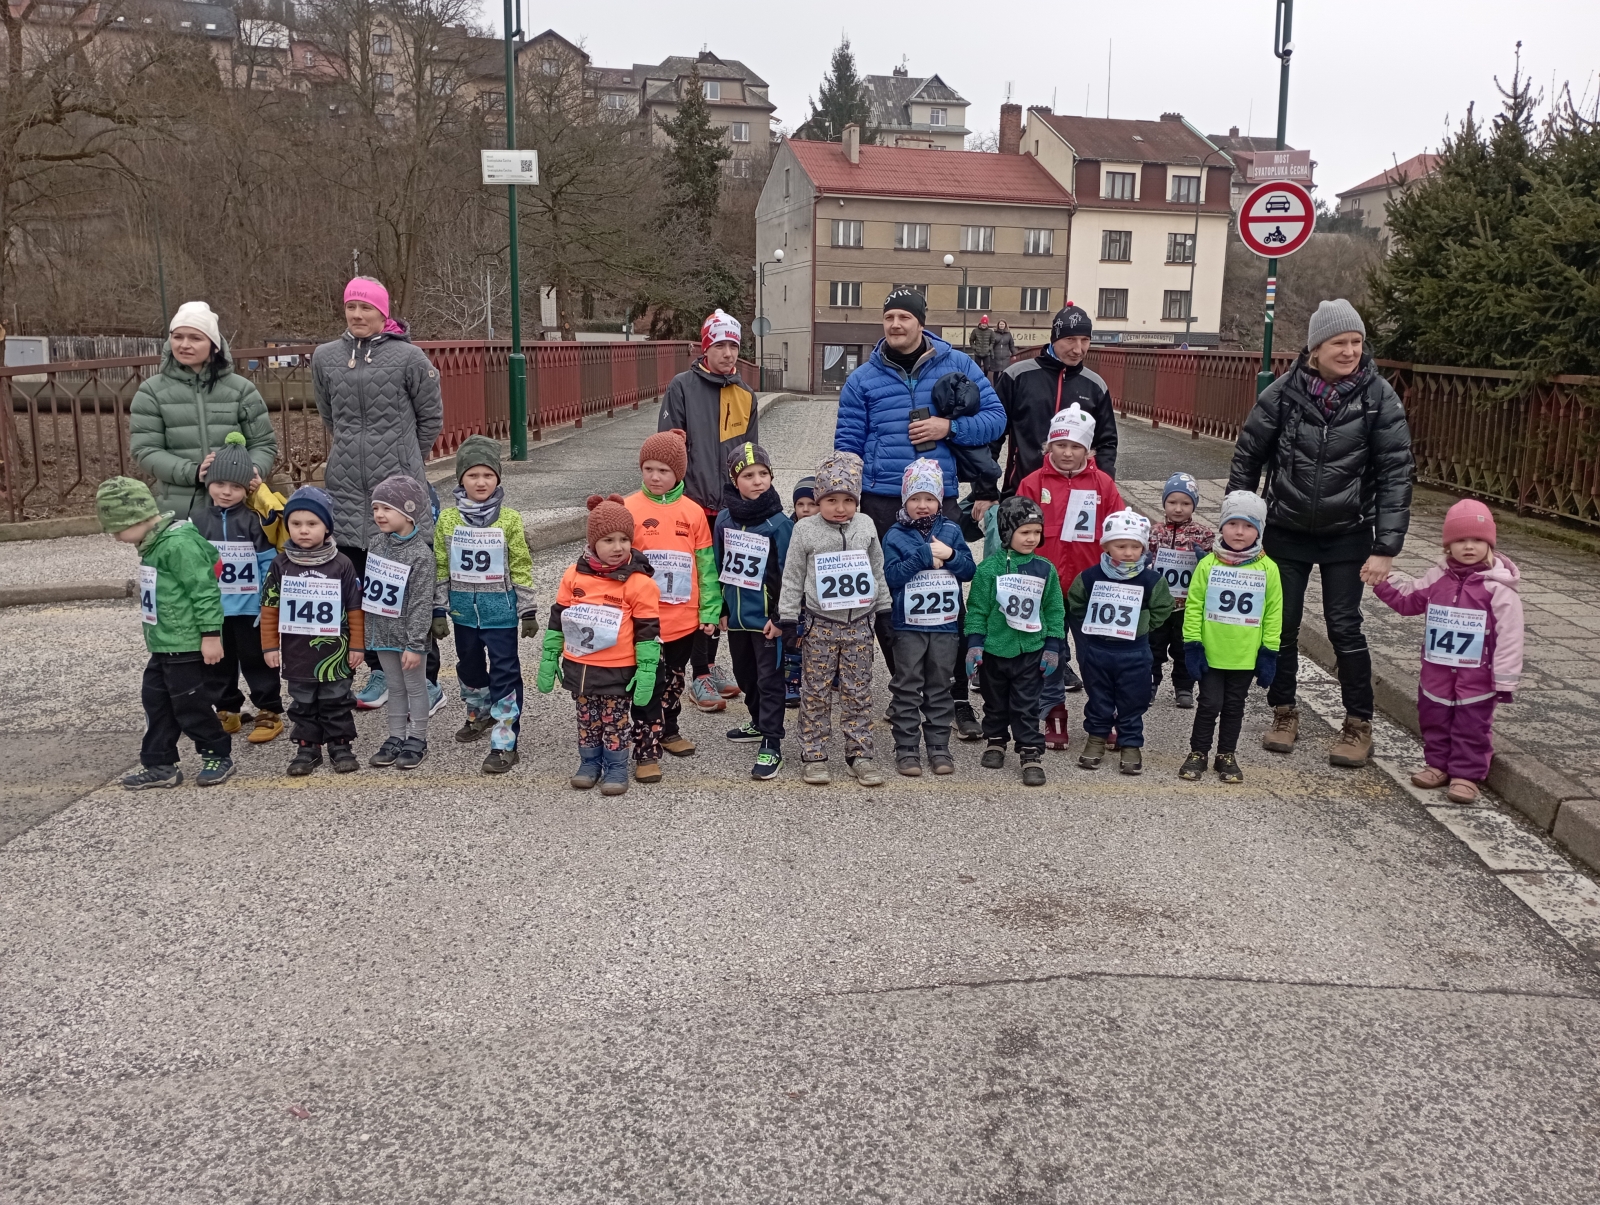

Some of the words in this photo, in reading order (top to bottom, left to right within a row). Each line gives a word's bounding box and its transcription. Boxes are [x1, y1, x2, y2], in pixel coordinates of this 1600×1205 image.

[1274, 154, 1290, 164] MOST
[1254, 166, 1288, 177] SVATOPLUKA
[1290, 164, 1308, 175] ČECHA
[1013, 333, 1036, 341] LORIE
[751, 544, 766, 552] LIGA
[460, 549, 491, 572] 59
[724, 551, 762, 578] 253
[817, 554, 841, 564] ZIMNÍ
[217, 563, 255, 584] 84
[283, 580, 308, 588] ZIMNÍ
[389, 572, 405, 581] LIGA
[664, 572, 674, 593] 1
[1212, 569, 1238, 578] ZIMNÍ
[363, 576, 399, 606] 293
[820, 572, 871, 599] 286
[142, 590, 153, 613] 4
[286, 599, 334, 624] 148
[909, 591, 955, 615] 225
[1005, 595, 1035, 620] 89
[1218, 590, 1254, 615] 96
[1429, 607, 1449, 617] ZIMNÍ
[600, 617, 618, 626] LIGA
[1090, 602, 1134, 627] 103
[1462, 620, 1483, 628] LIGA
[580, 626, 594, 650] 2
[1429, 628, 1475, 655] 147
